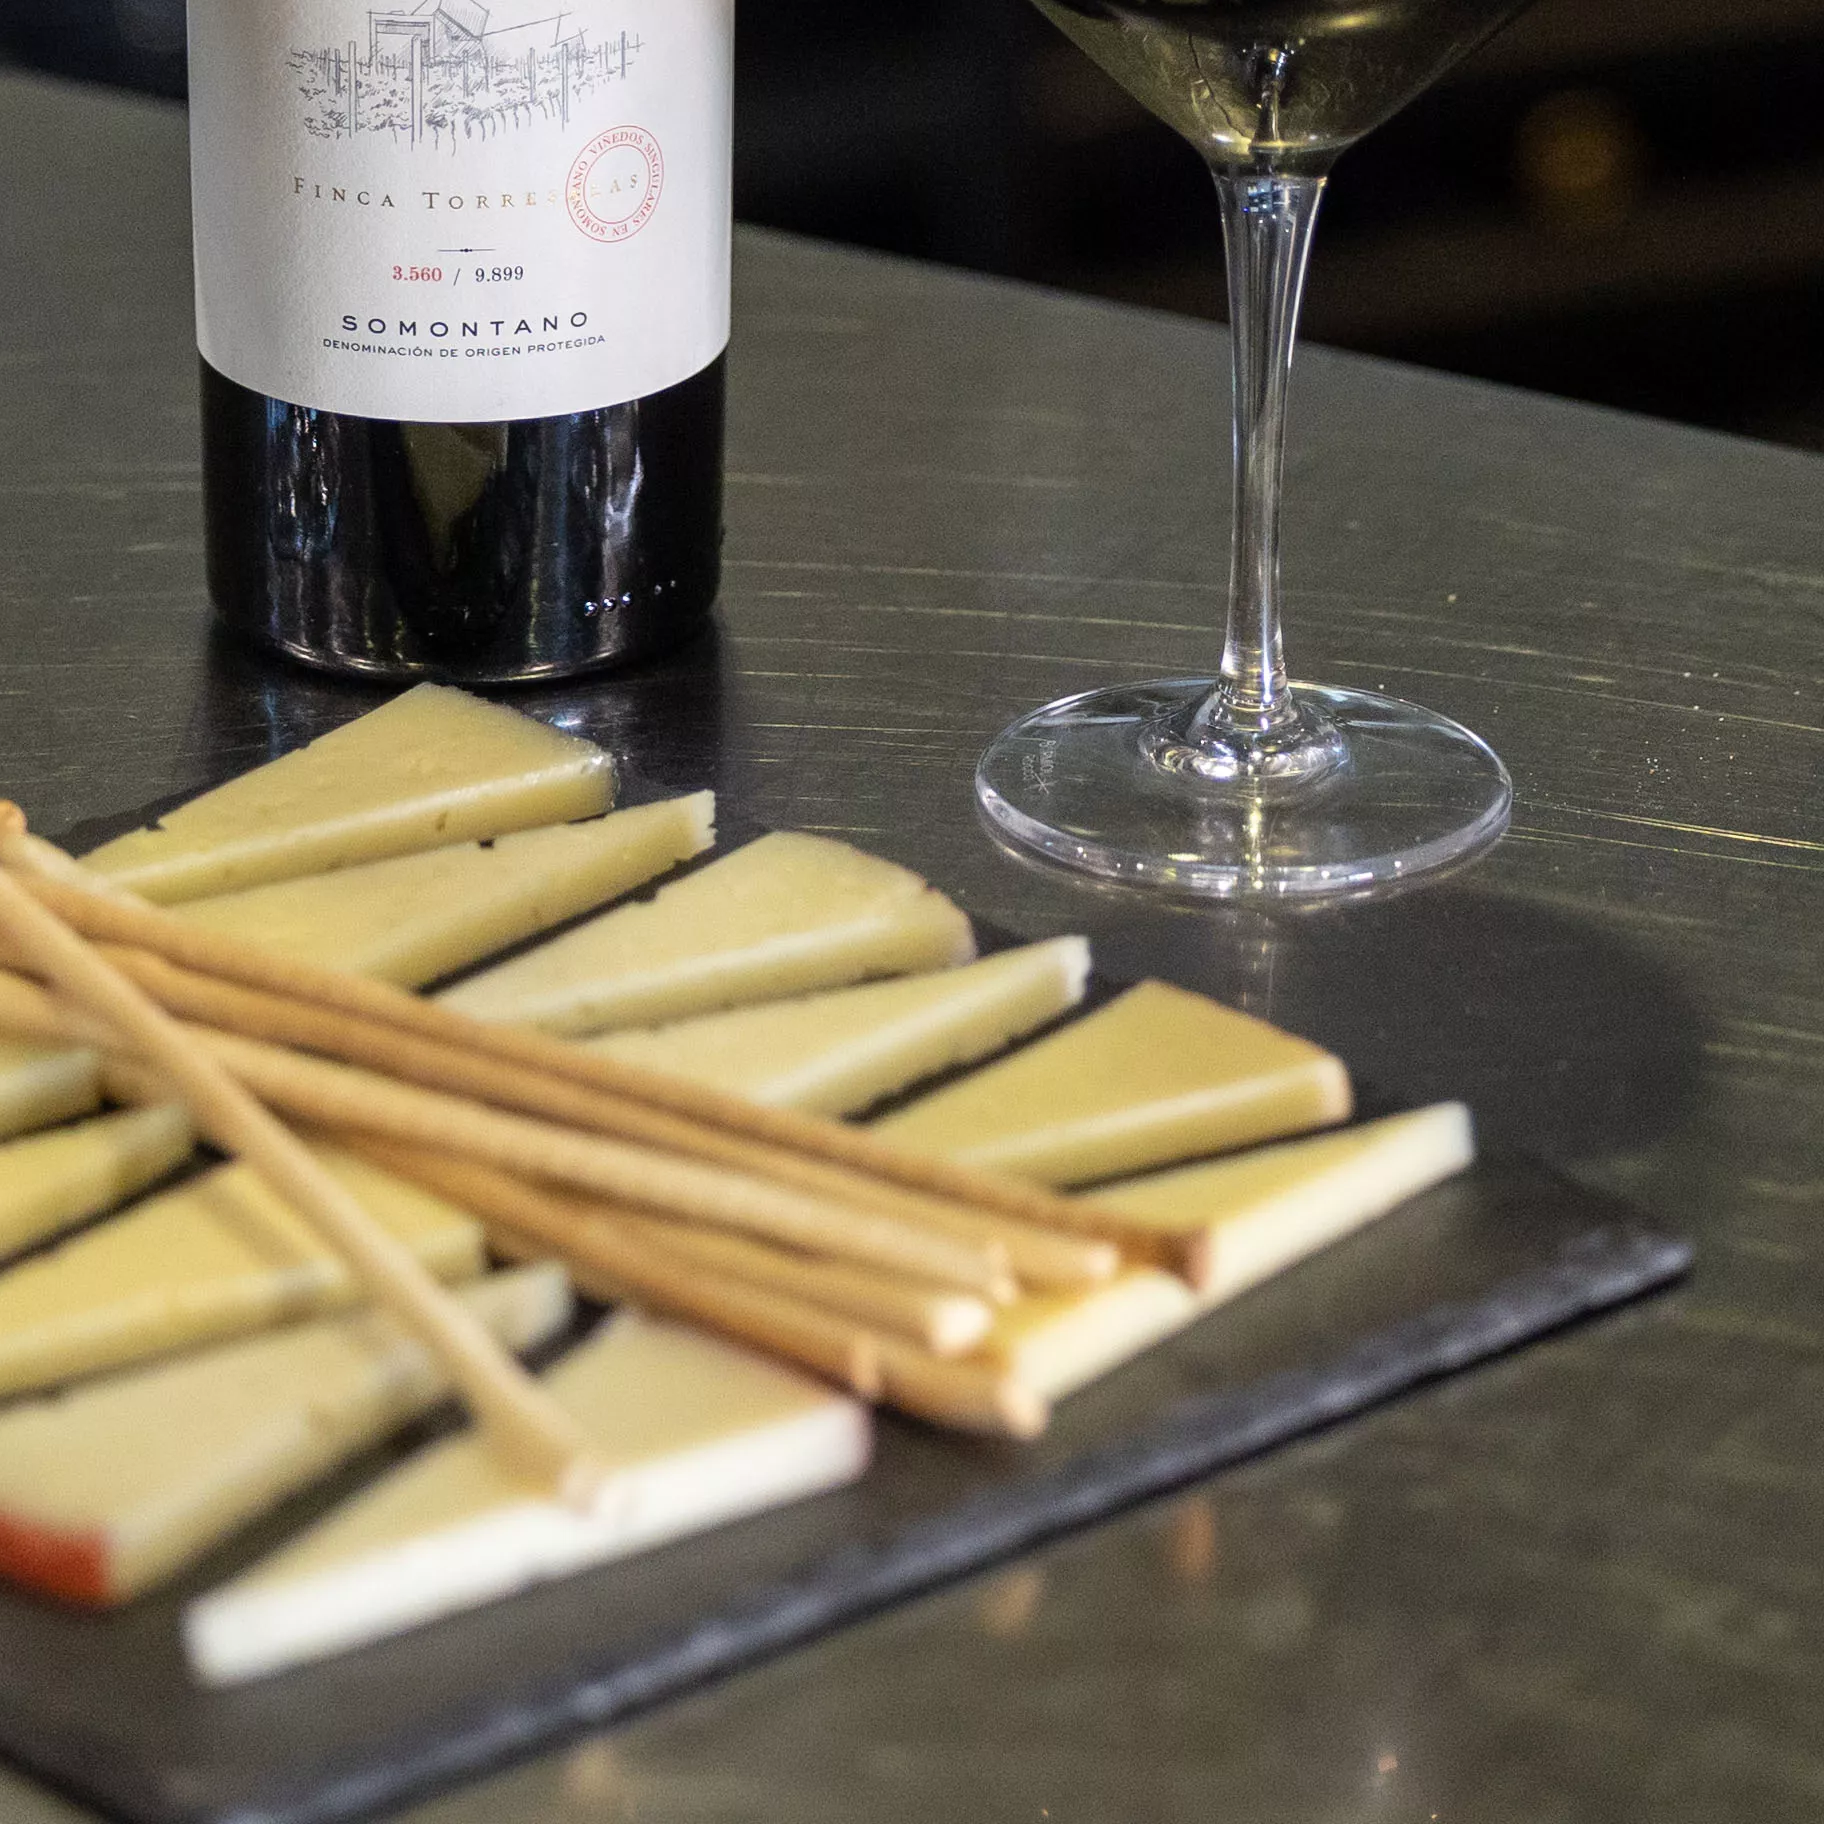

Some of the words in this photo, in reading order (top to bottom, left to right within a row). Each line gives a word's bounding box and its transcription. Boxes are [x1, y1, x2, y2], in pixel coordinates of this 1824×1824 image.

[293, 177, 395, 208] FINCA
[392, 265, 442, 282] 3.560
[453, 268, 461, 286] /
[475, 265, 524, 282] 9.899
[342, 311, 588, 337] SOMONTANO
[323, 338, 432, 358] DENOMINACIÓN
[440, 348, 458, 358] DE
[465, 346, 521, 357] ORIGEN
[527, 335, 606, 353] PROTEGIDA
